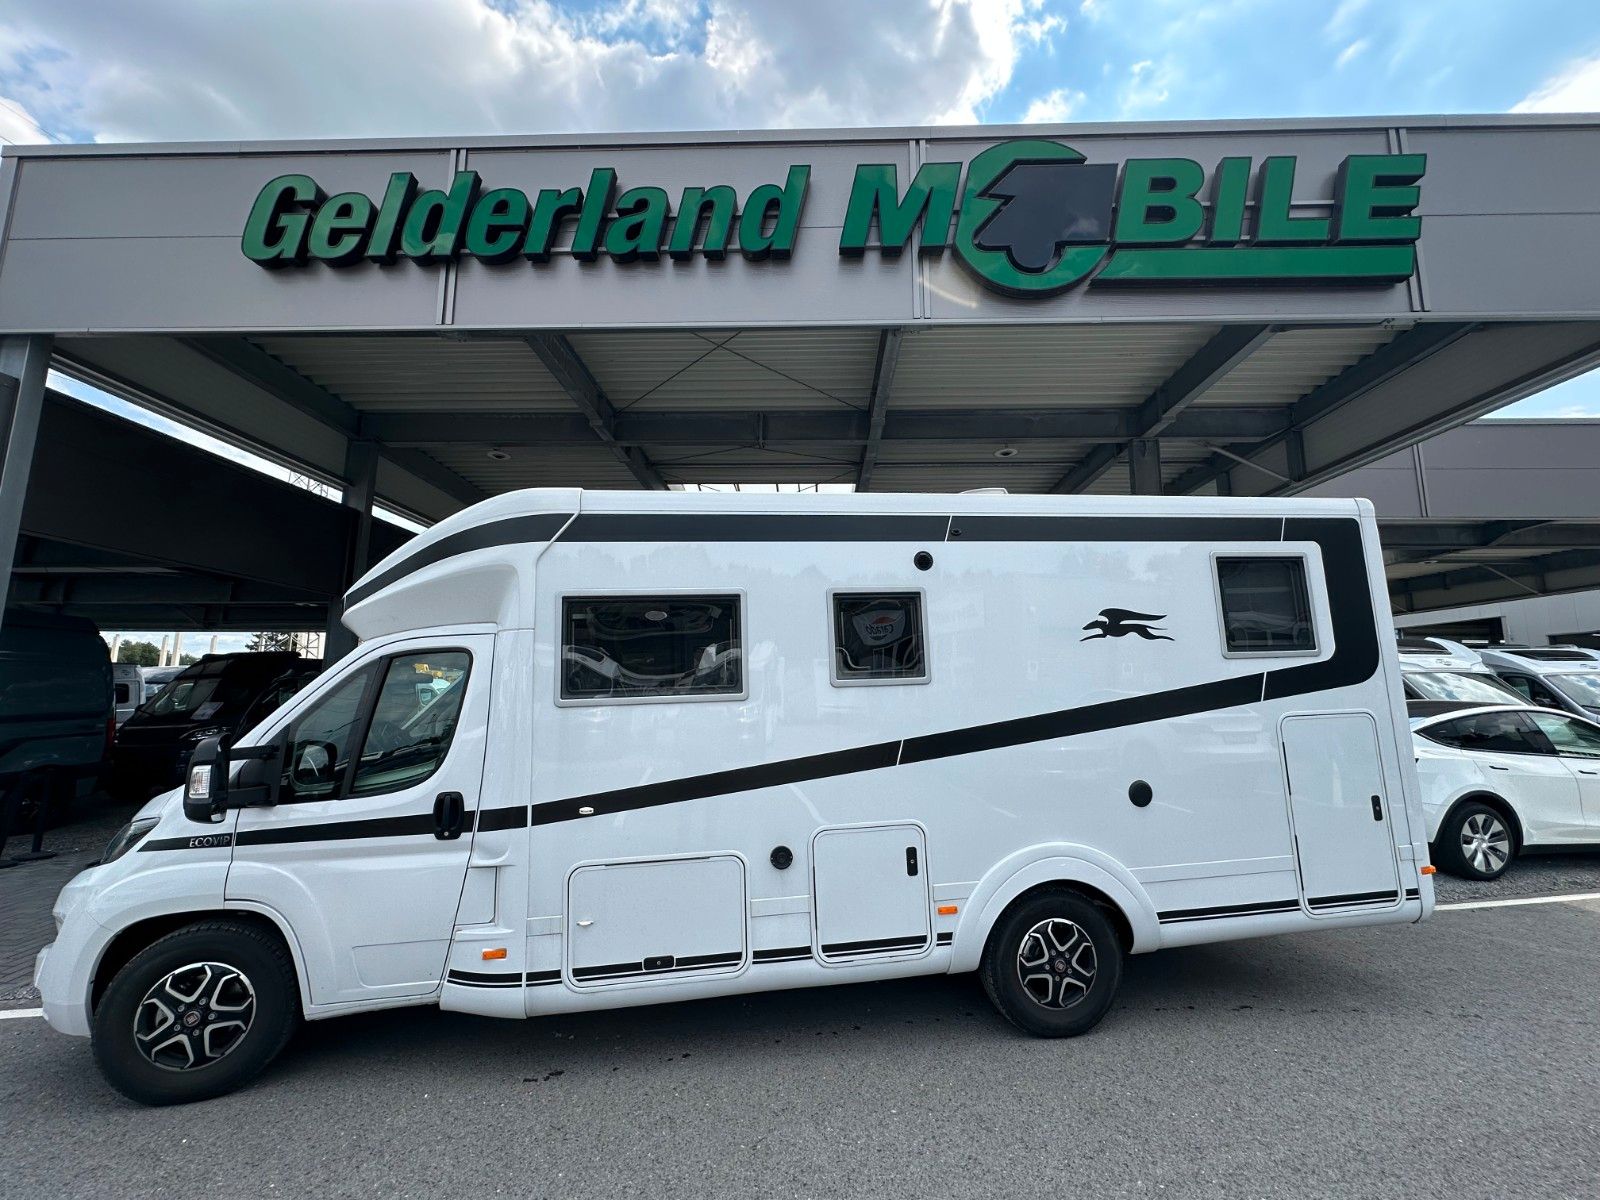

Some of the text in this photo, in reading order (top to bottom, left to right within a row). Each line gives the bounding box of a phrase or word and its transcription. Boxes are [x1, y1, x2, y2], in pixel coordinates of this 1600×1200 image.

[240, 139, 1427, 294] Gelderland MOBILE
[189, 836, 230, 847] ECOVIP
